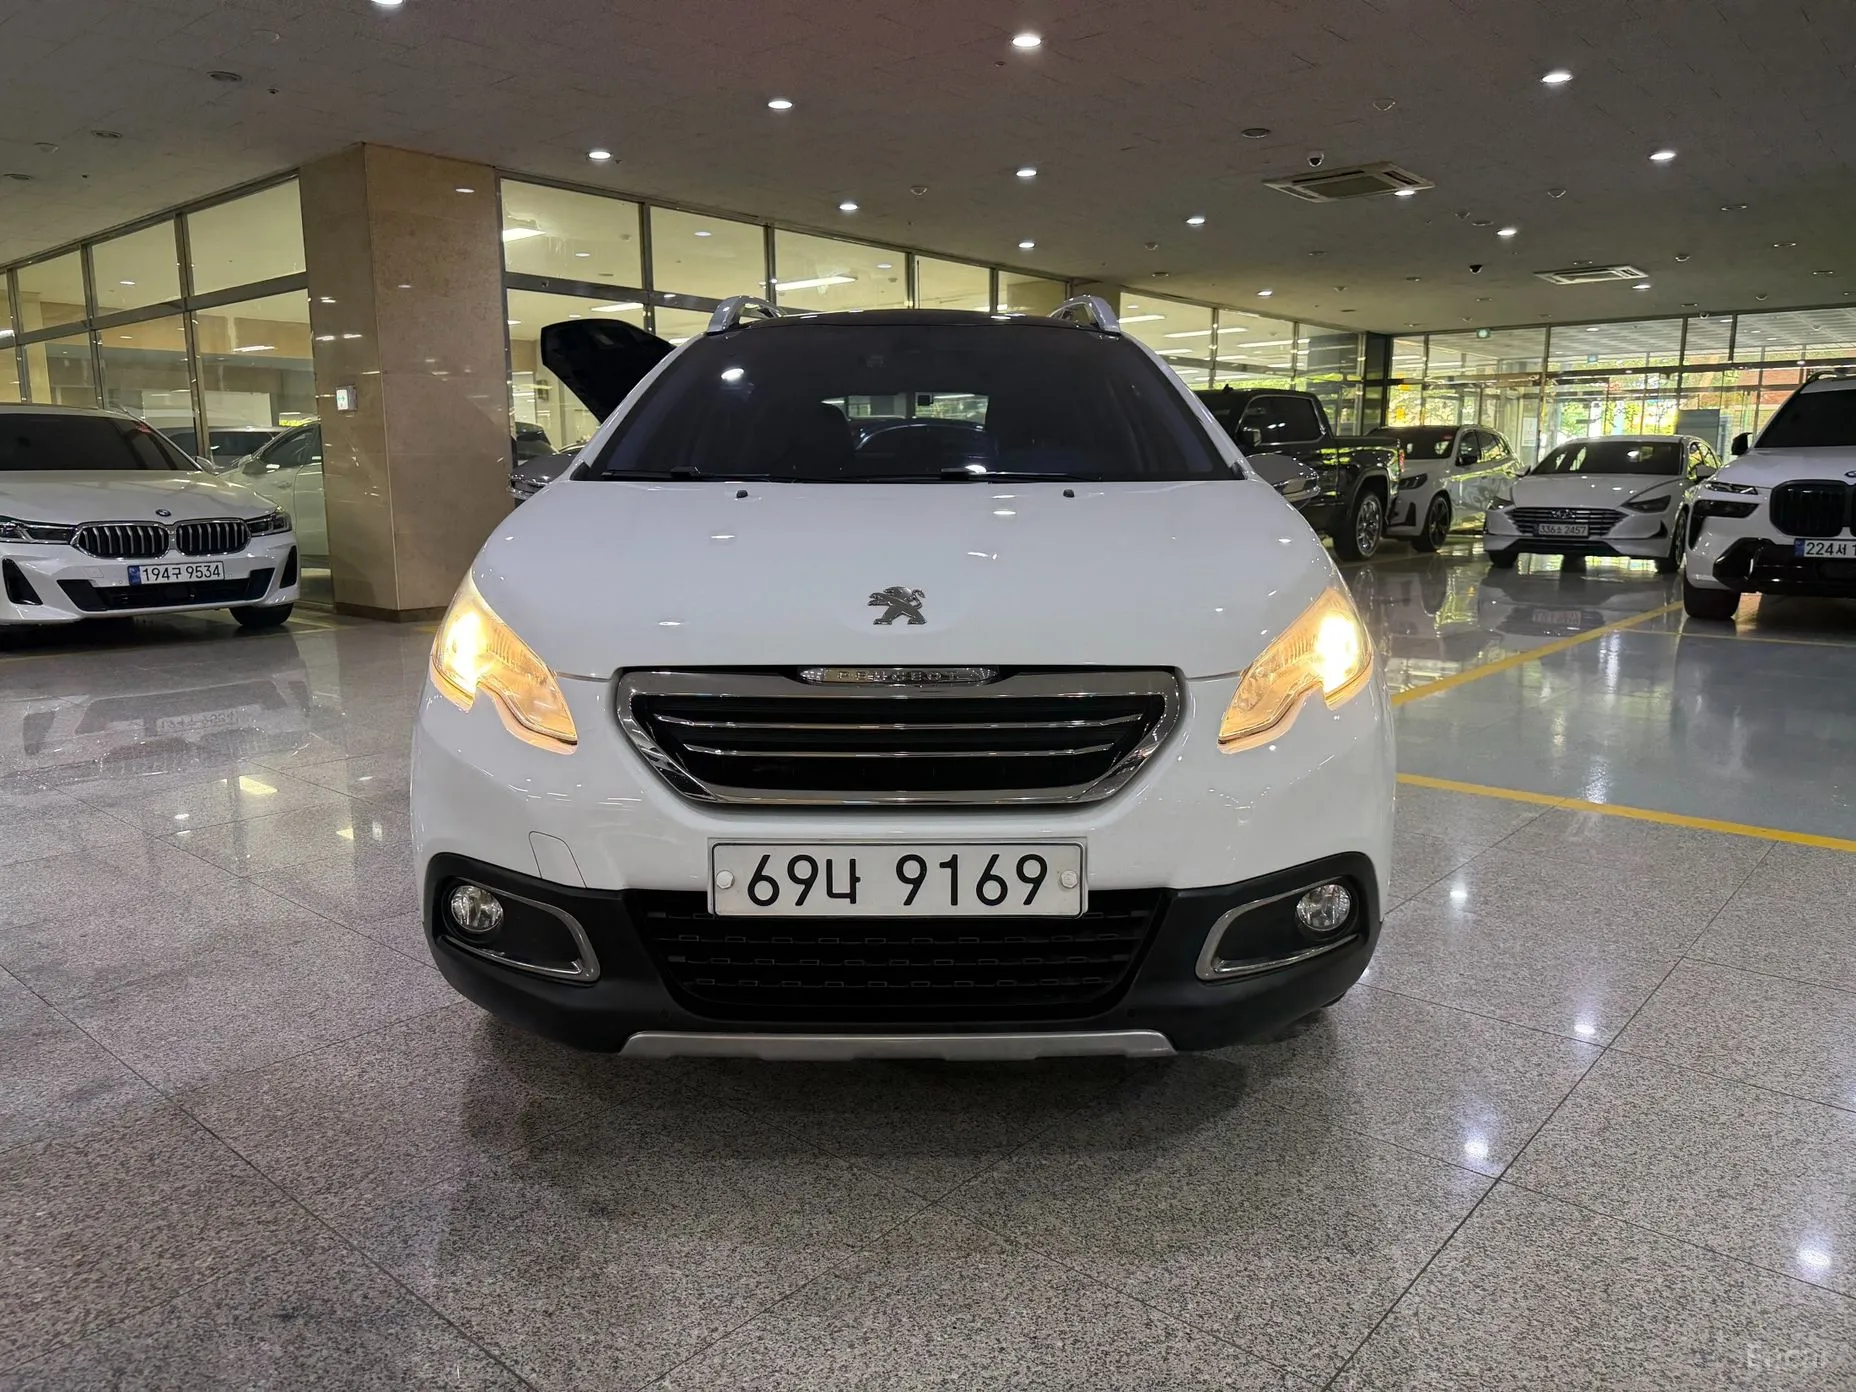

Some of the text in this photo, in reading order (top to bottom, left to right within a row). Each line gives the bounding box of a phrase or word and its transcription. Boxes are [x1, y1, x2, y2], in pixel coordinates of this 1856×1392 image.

[1564, 525, 1587, 534] 2457
[1806, 541, 1847, 556] 224서
[142, 564, 221, 581] 194구 9534
[747, 853, 1048, 907] 69나 9169
